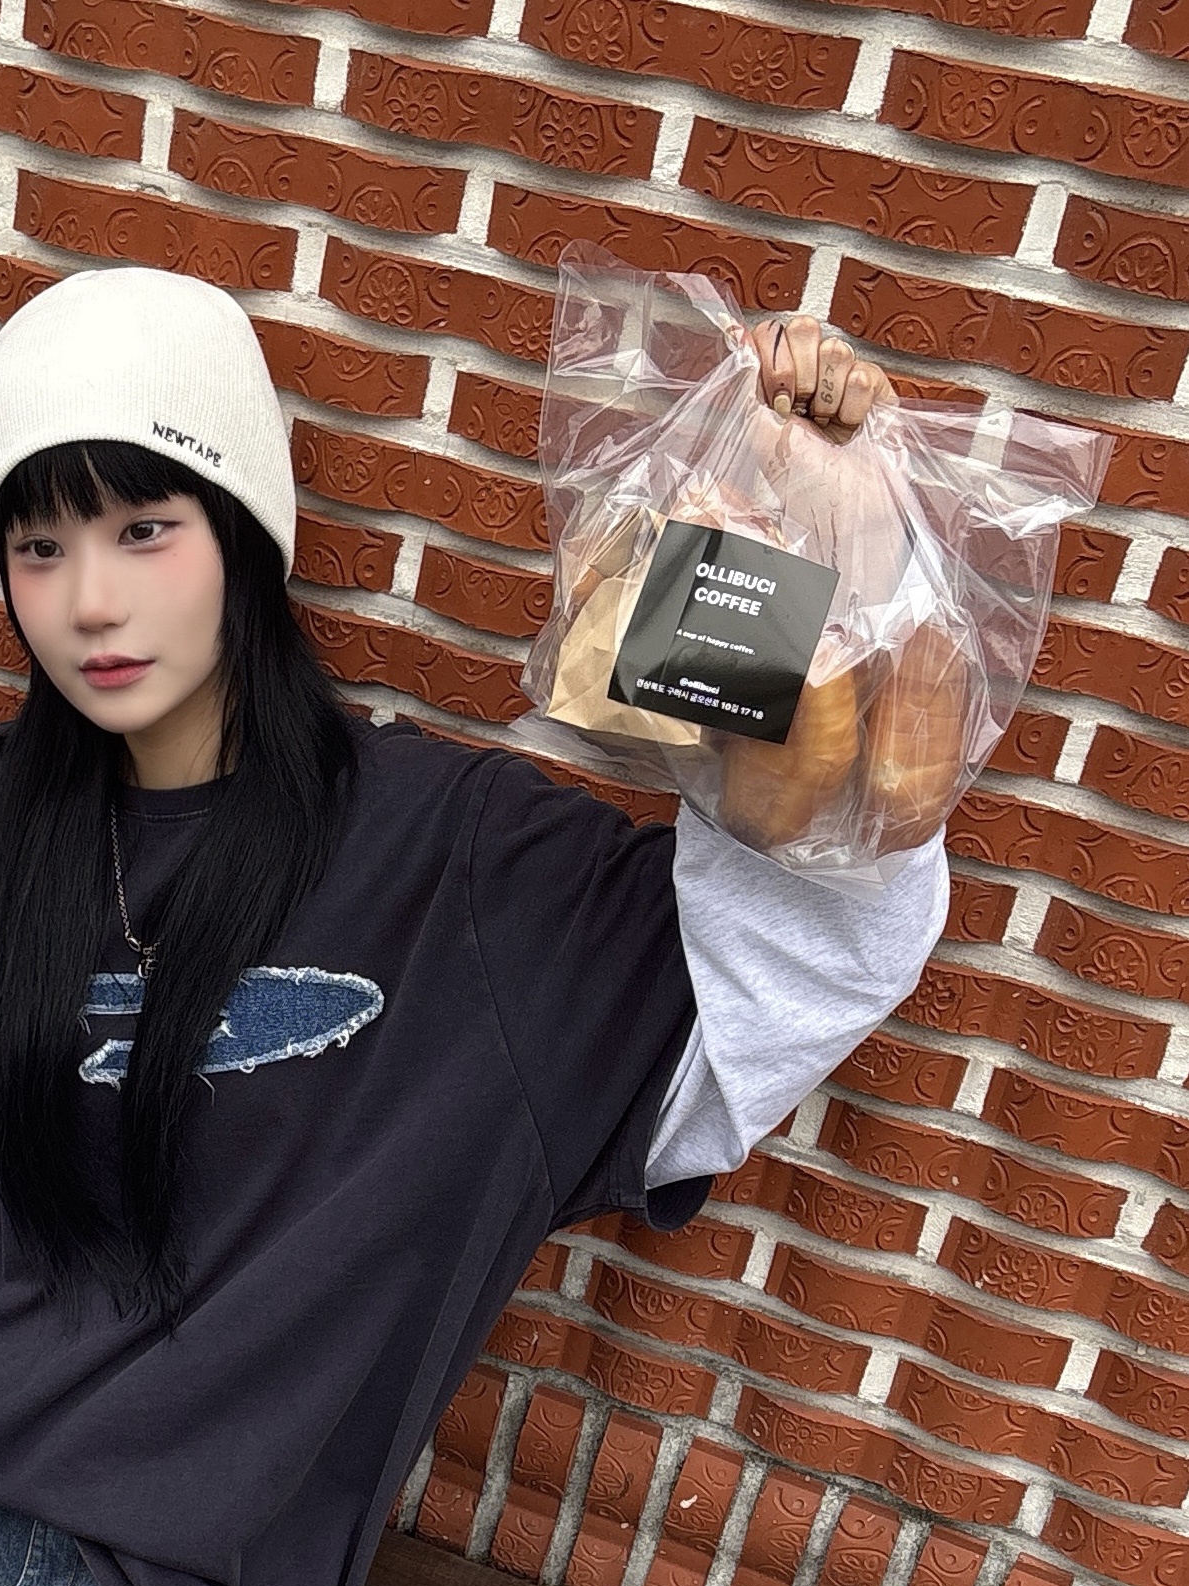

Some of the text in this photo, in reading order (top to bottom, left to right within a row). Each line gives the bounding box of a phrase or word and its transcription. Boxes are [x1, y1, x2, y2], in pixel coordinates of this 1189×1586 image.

[152, 420, 222, 468] NEWTAPE
[696, 562, 776, 595] OLLIBUCI
[694, 587, 762, 616] COFFEE
[676, 628, 682, 636] A
[682, 631, 698, 640] cup
[706, 636, 729, 649] happy
